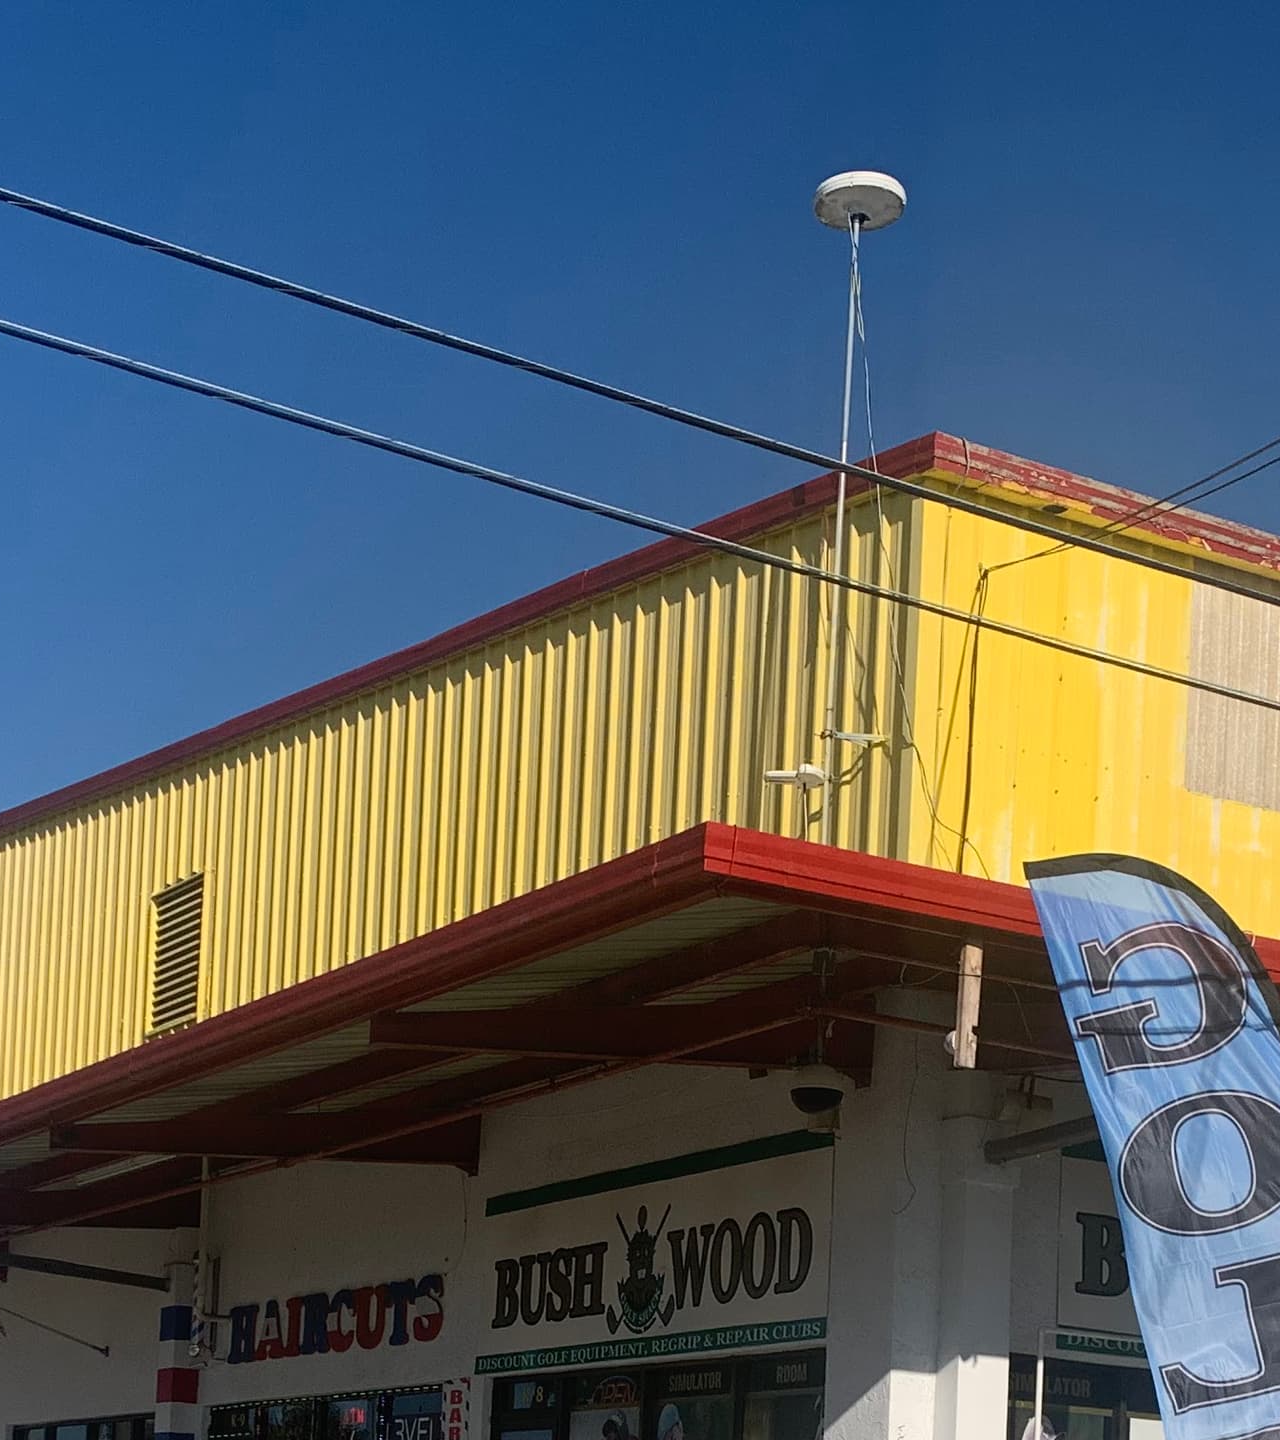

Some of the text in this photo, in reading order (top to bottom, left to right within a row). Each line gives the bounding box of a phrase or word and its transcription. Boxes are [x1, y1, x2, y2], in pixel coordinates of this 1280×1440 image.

[666, 1207, 813, 1310] WOOD
[491, 1241, 609, 1329] BUSH
[226, 1274, 445, 1364] HAIRCUTS
[478, 1321, 821, 1371] DISCOUNT GOLF EQUIPMENT, REGRIP & REPAIR CLUBS
[1065, 1335, 1145, 1354] DISCOU
[668, 1363, 808, 1393] SIMULATOR ROOM
[1011, 1373, 1091, 1398] SIMLATOR
